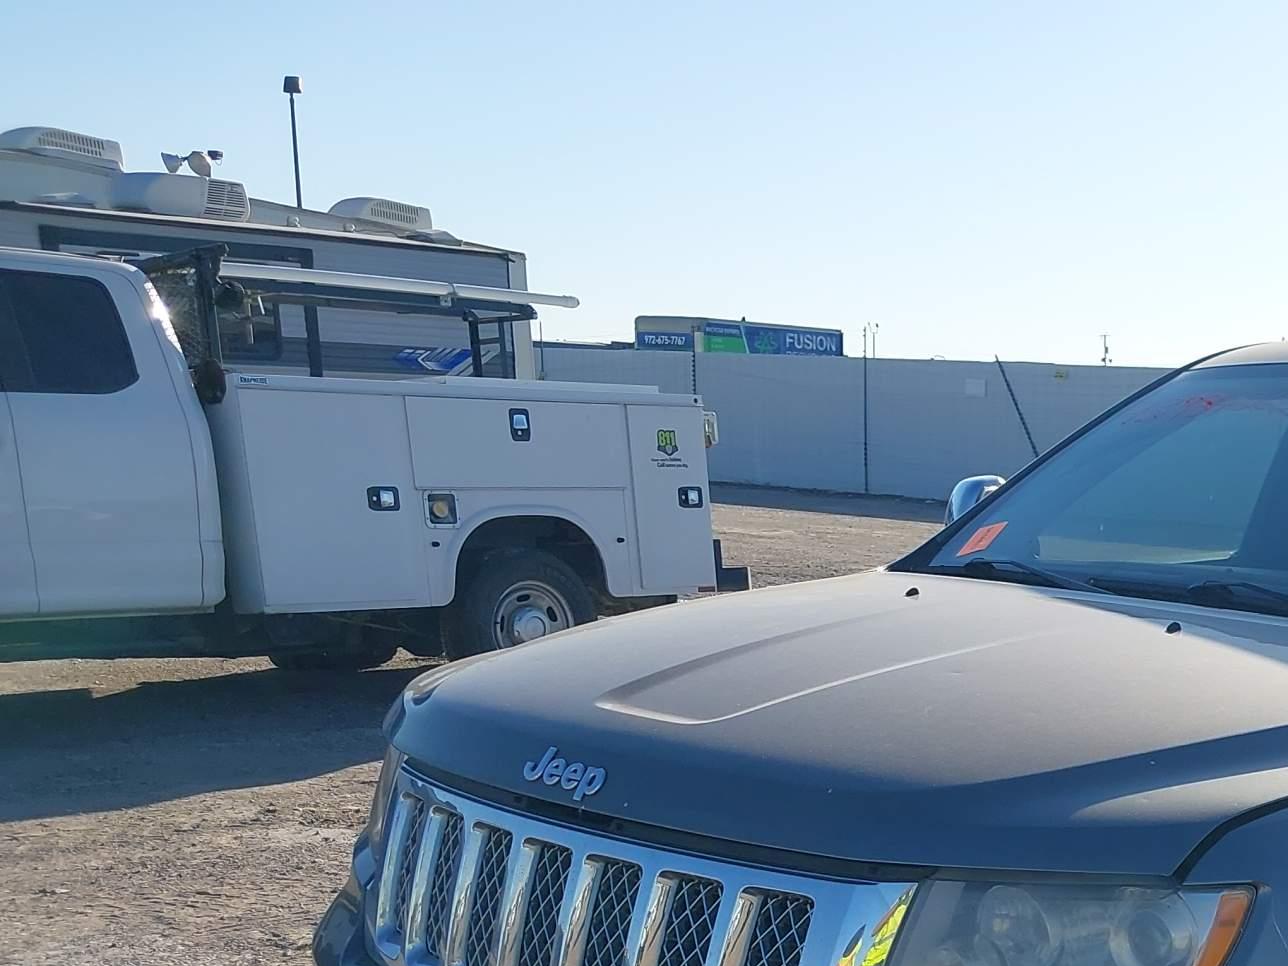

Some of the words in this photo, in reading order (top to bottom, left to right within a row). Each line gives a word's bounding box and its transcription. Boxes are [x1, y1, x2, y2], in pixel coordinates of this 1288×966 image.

[786, 333, 837, 352] FUSION
[658, 431, 676, 447] 811
[523, 745, 607, 801] Jeep
